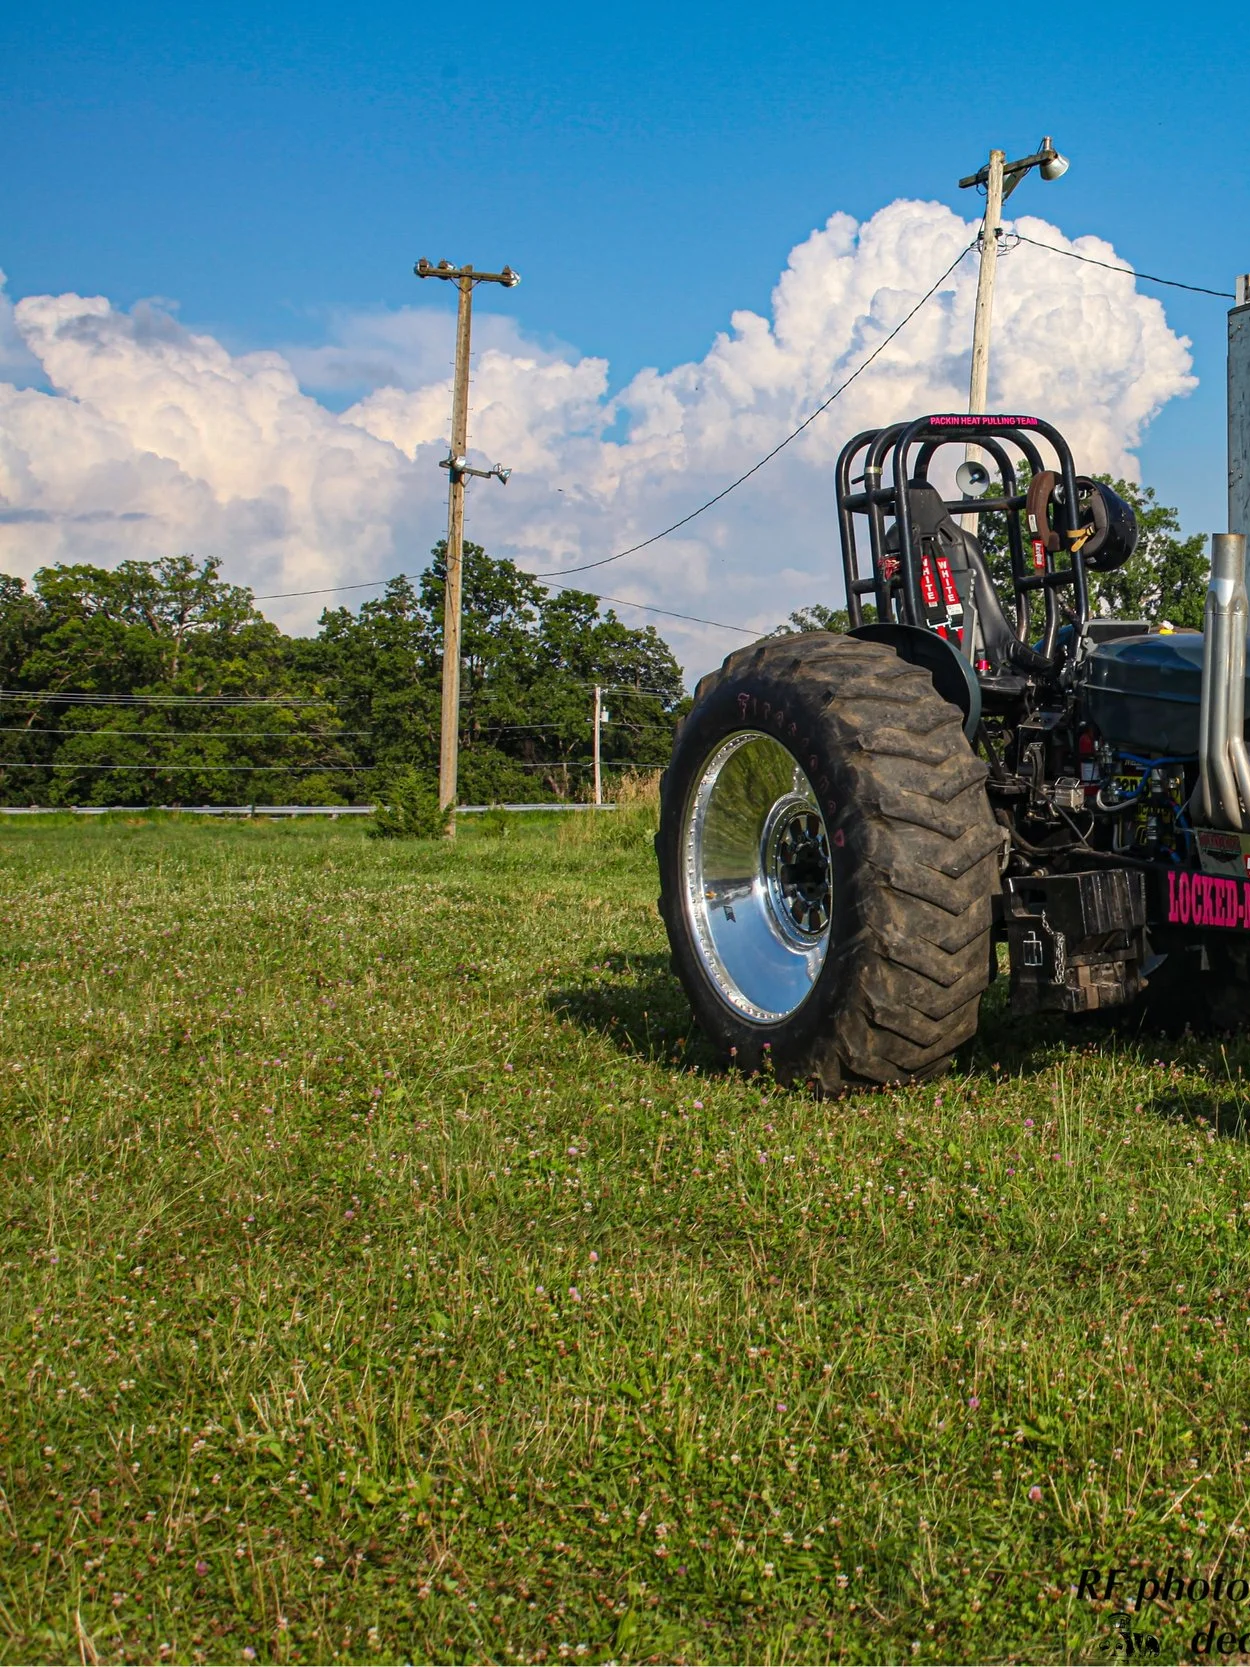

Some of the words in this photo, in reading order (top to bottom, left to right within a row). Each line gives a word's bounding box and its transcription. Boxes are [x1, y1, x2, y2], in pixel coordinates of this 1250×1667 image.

[930, 416, 959, 425] PACKIN
[961, 416, 980, 425] HEAT
[982, 416, 1016, 425] PULLING
[1017, 416, 1038, 425] TEAM
[937, 560, 956, 602] WHITE
